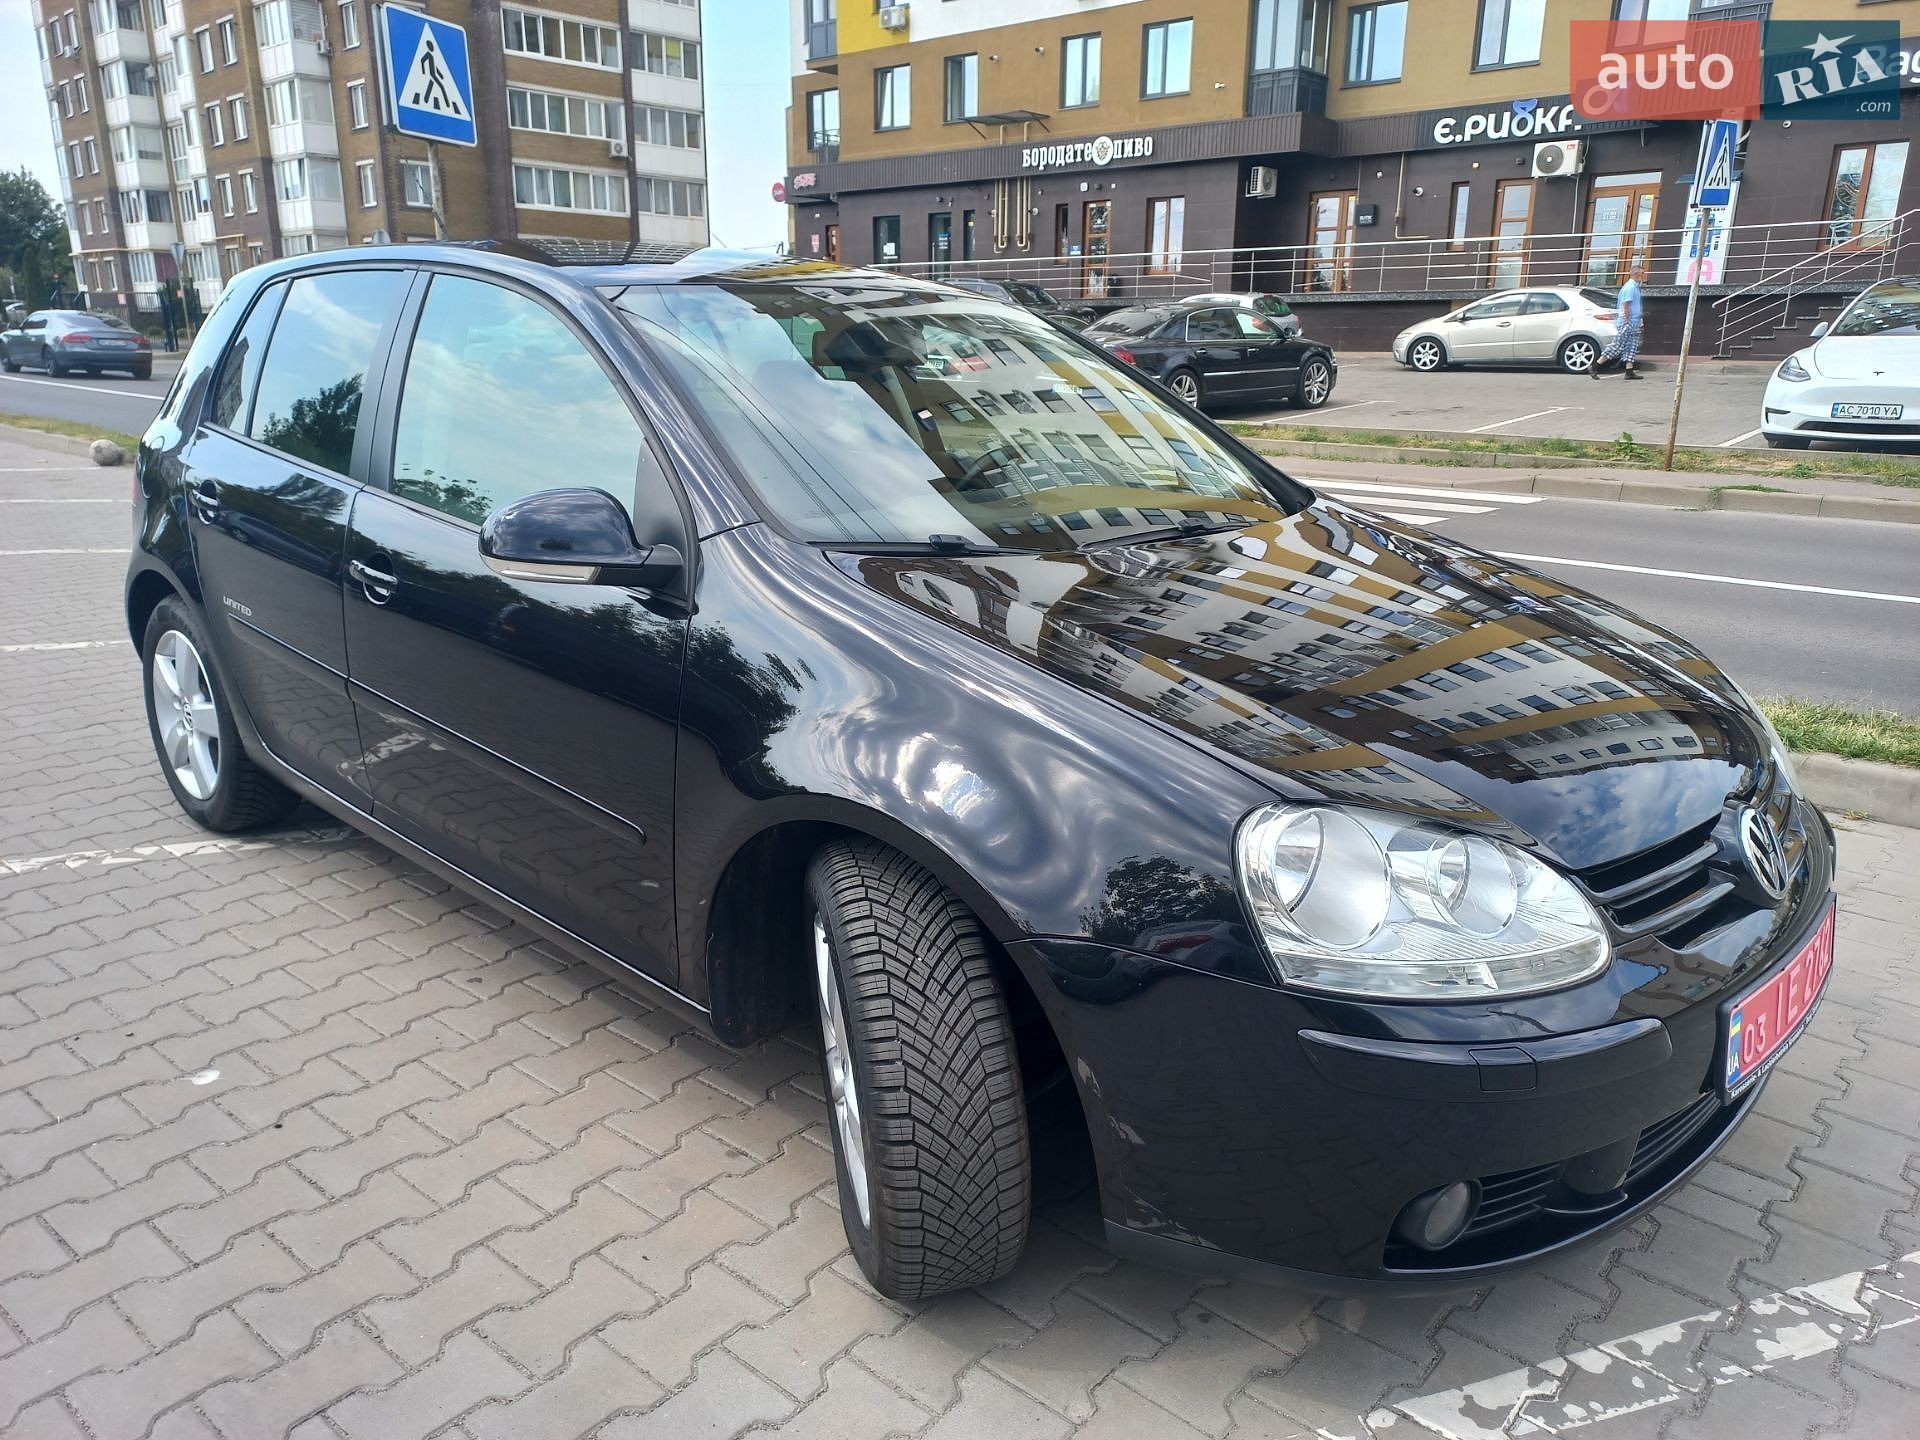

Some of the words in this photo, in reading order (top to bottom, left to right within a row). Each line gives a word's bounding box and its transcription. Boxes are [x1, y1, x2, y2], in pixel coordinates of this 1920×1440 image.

[1839, 405, 1855, 415] AC
[1856, 406, 1881, 415] 7010
[1883, 406, 1898, 416] YA
[223, 595, 252, 616] UNITED
[1743, 1012, 1767, 1064] 03
[1727, 1052, 1740, 1078] UA
